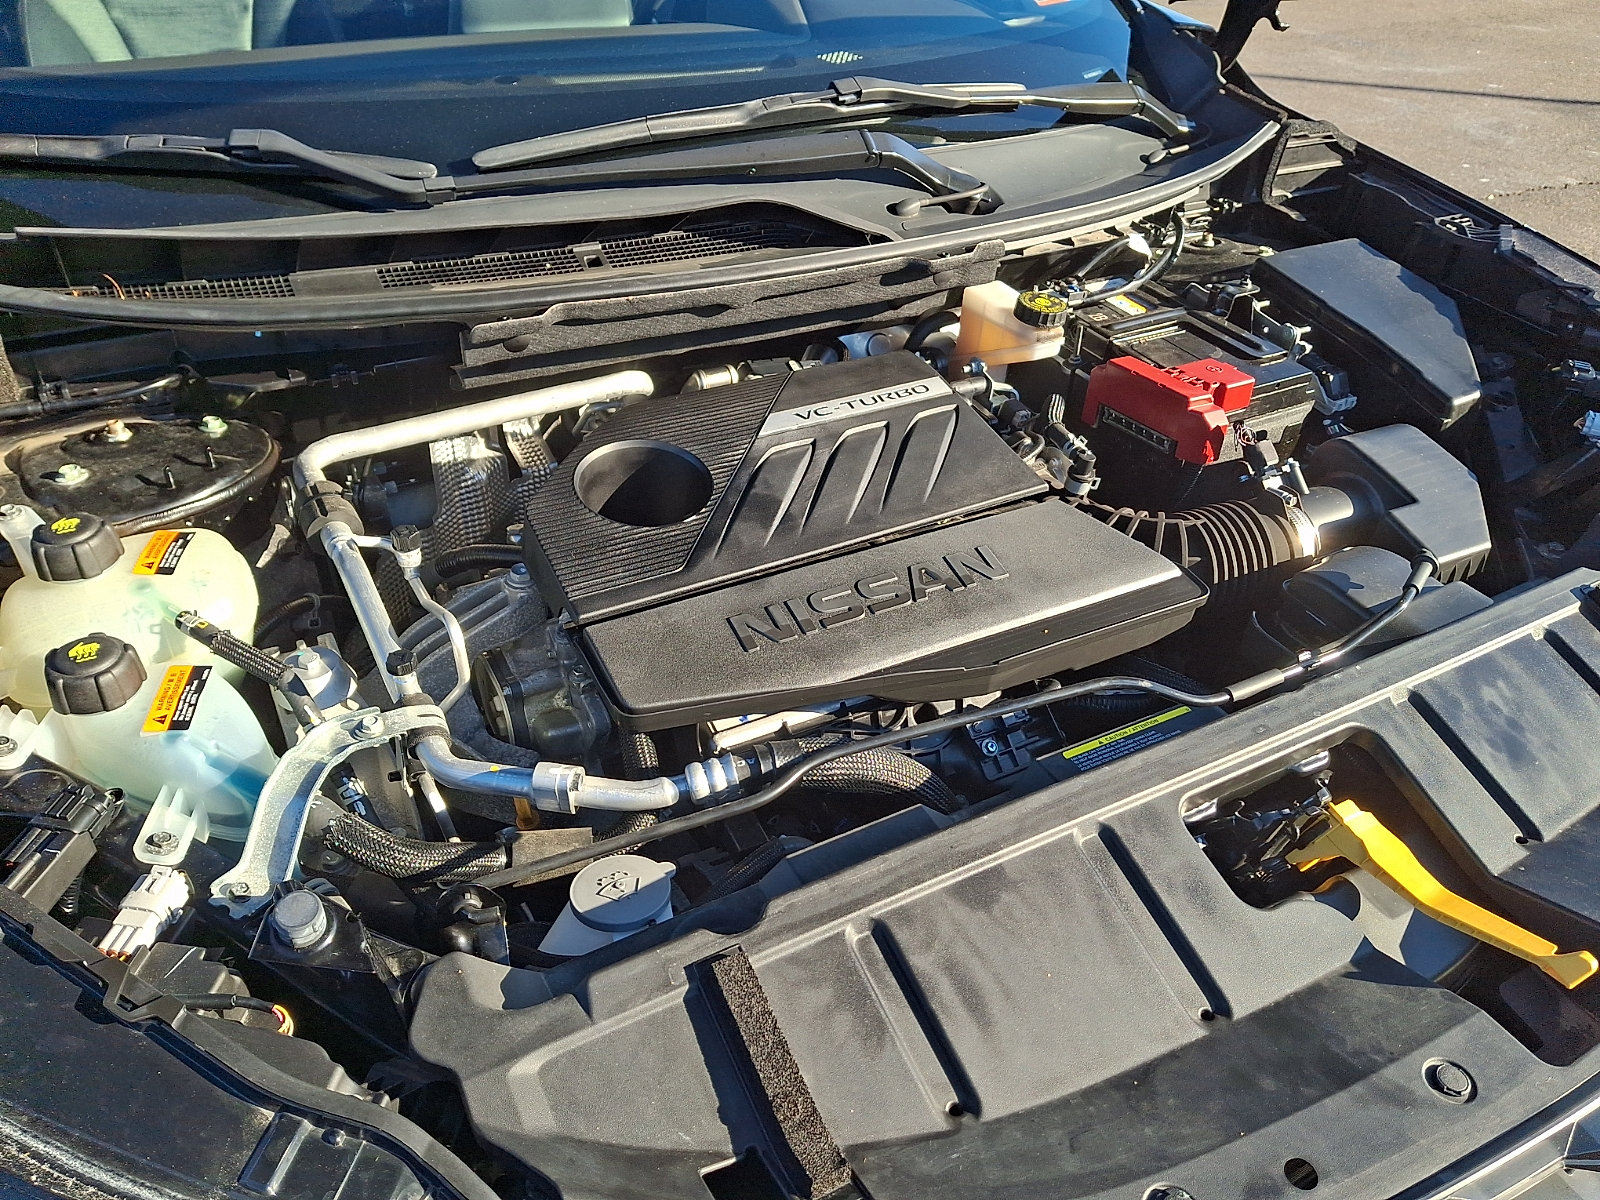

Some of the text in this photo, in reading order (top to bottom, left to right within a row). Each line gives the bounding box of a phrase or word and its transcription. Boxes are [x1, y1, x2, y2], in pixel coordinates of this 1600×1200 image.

[794, 384, 930, 420] VC-TURBO
[726, 545, 1009, 652] NISSAN
[1104, 731, 1128, 742] CAUTION
[1132, 718, 1159, 732] ATTENTION
